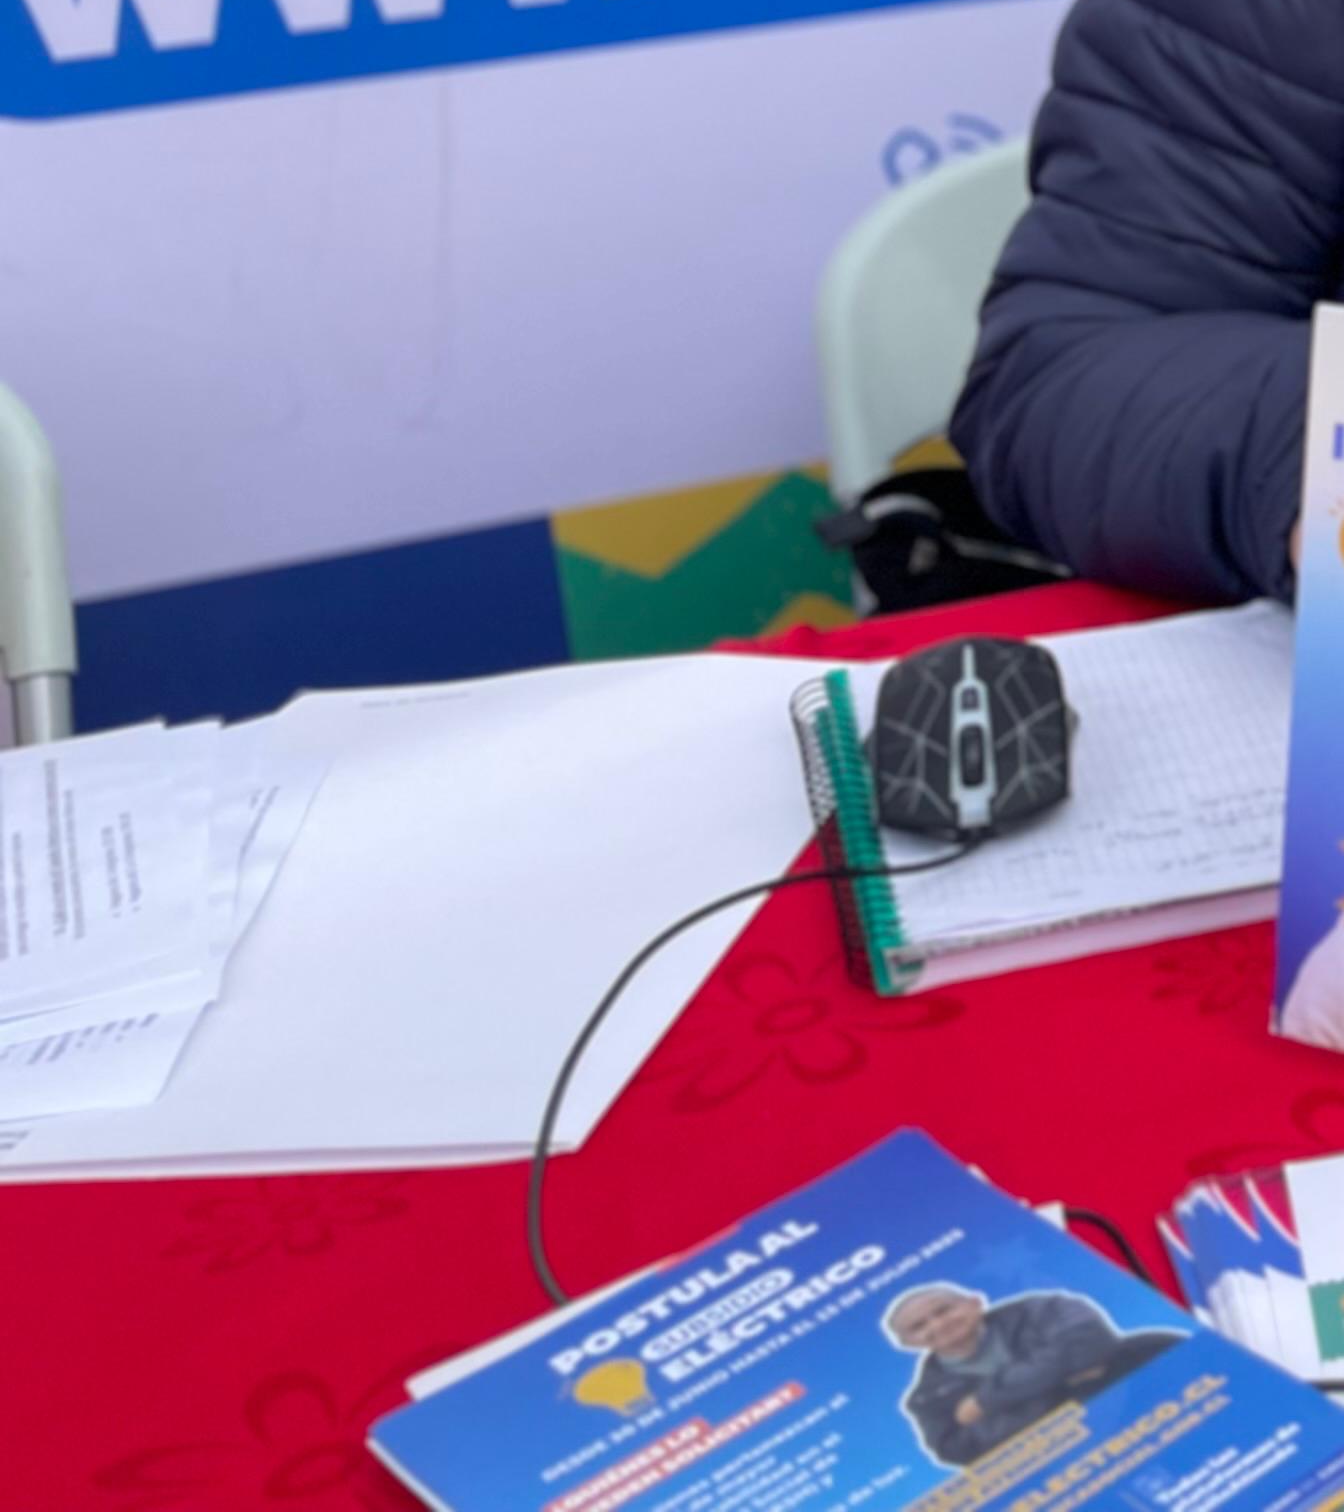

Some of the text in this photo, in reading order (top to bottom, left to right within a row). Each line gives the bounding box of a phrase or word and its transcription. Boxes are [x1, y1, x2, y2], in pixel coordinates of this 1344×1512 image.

[547, 1218, 820, 1376] POSTULA AL
[658, 1244, 887, 1383] ELÉCTRICO
